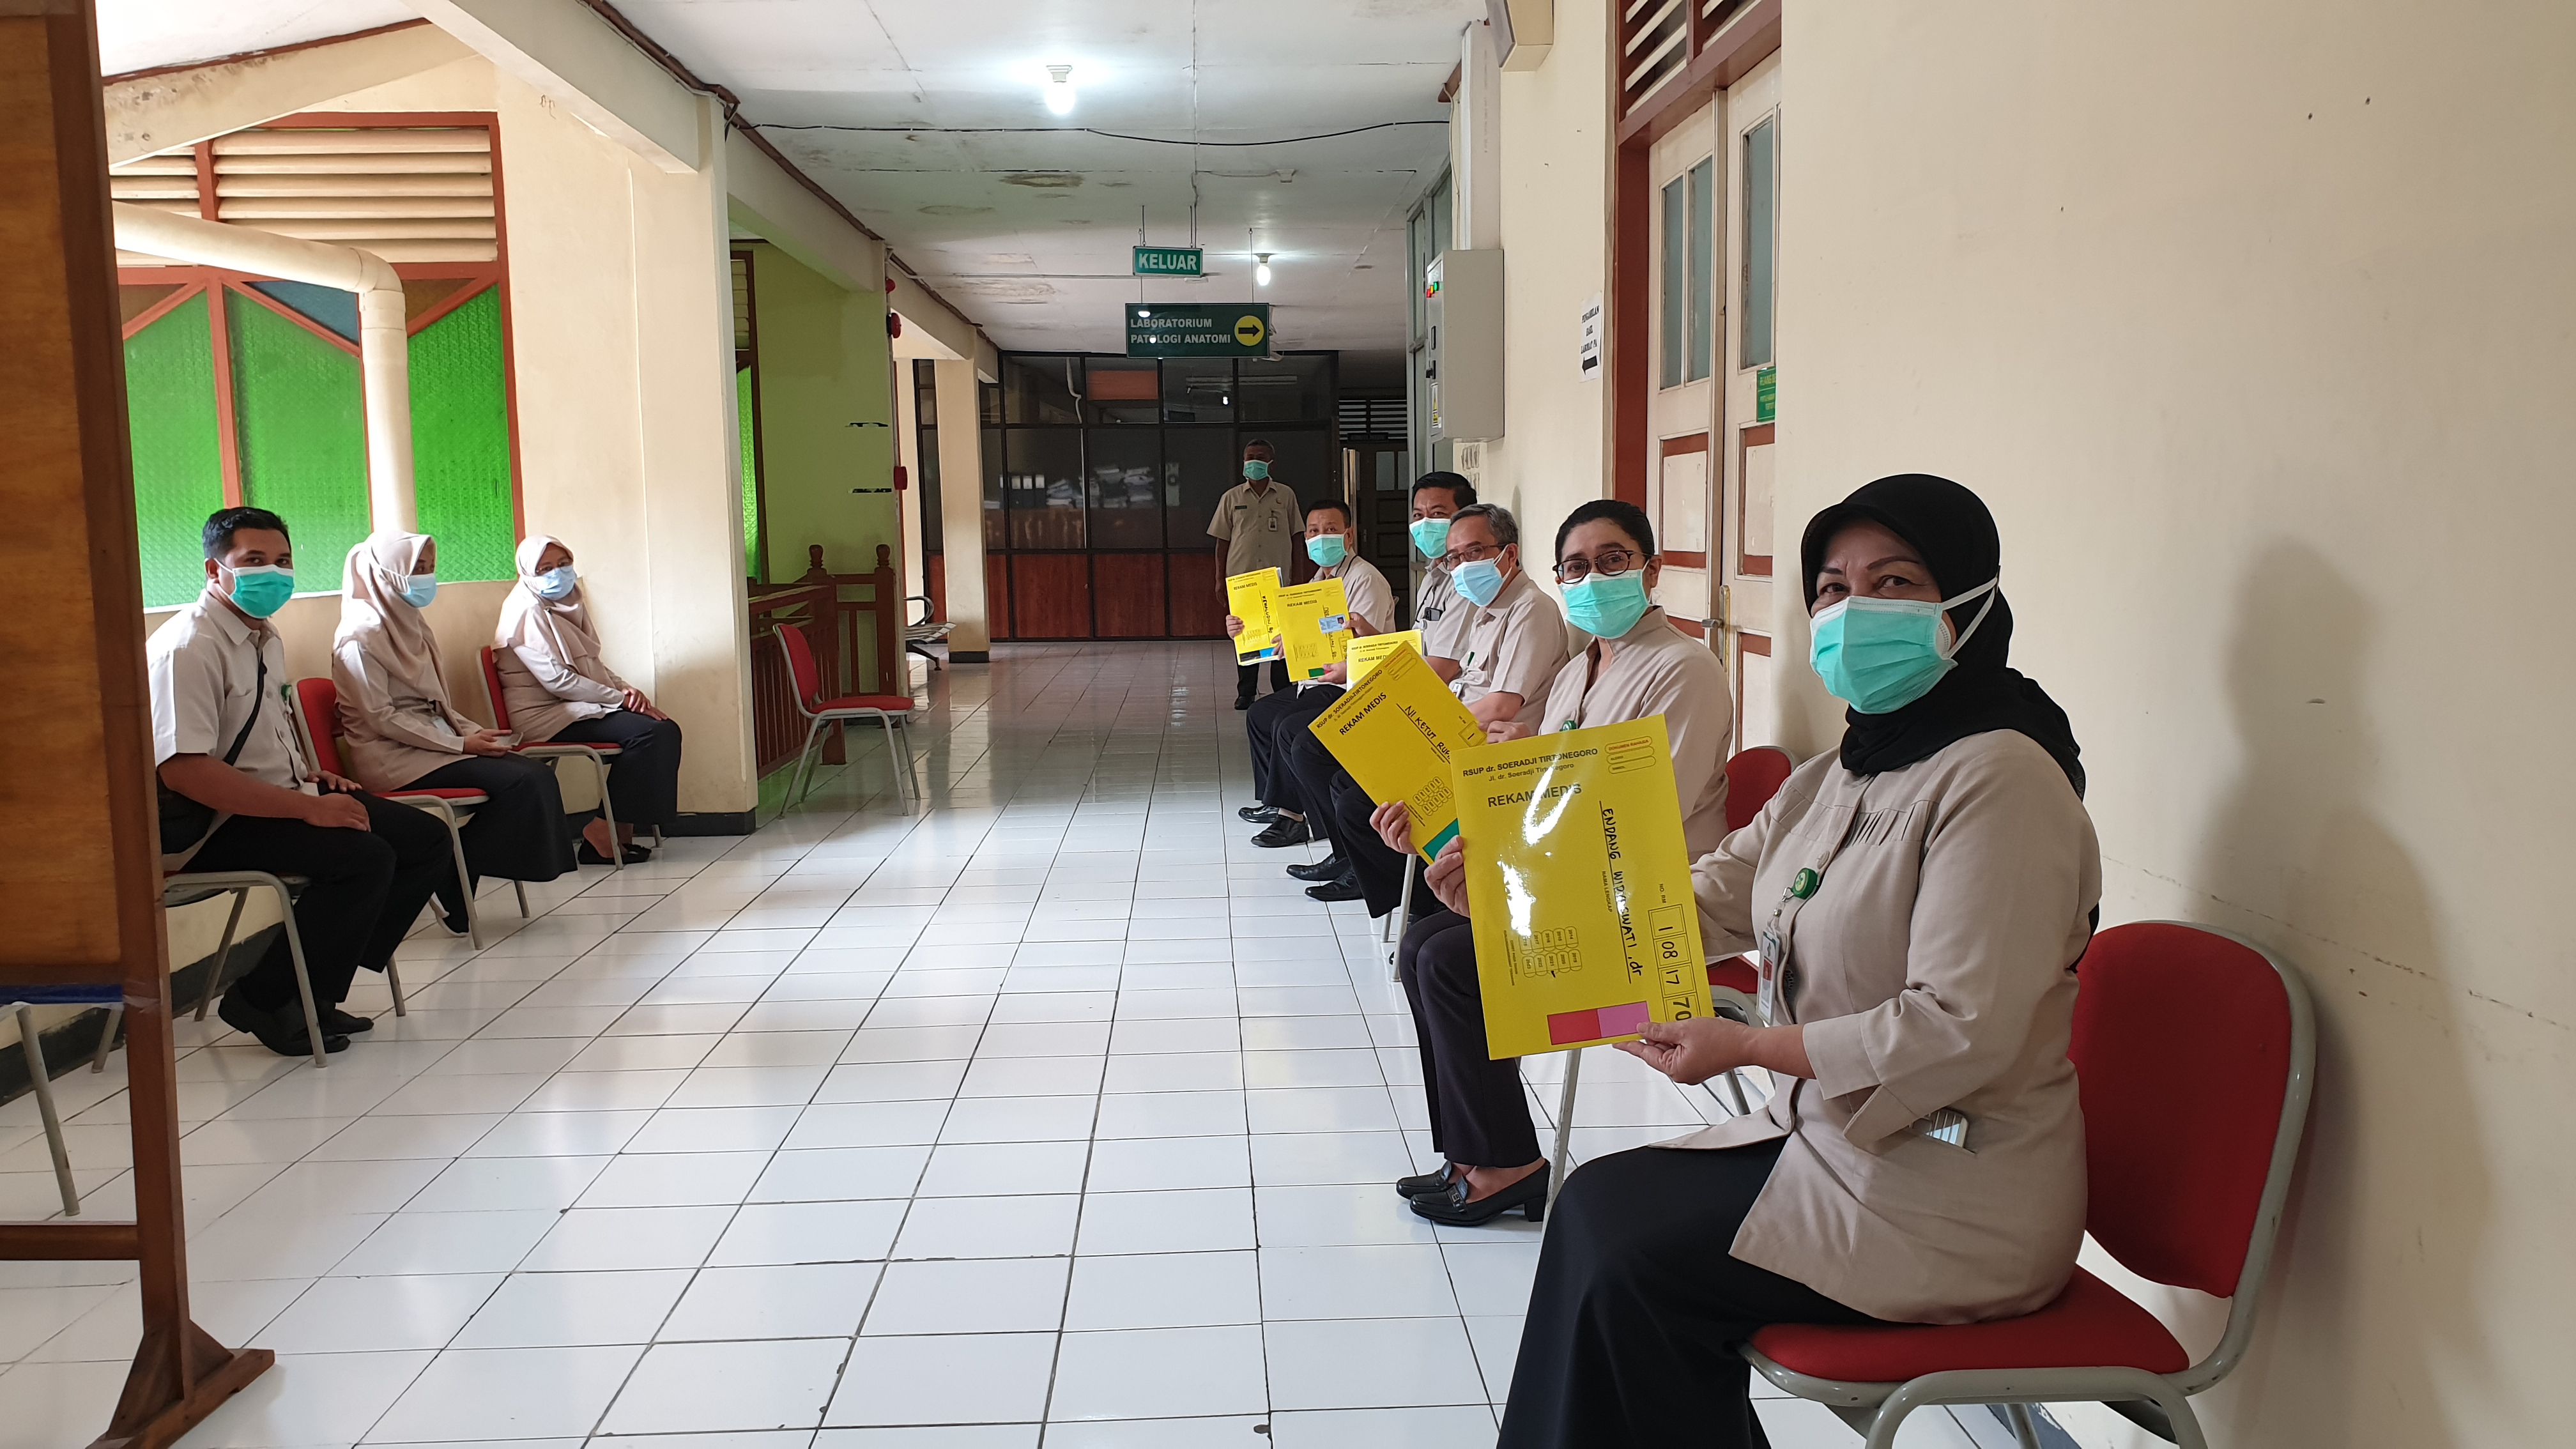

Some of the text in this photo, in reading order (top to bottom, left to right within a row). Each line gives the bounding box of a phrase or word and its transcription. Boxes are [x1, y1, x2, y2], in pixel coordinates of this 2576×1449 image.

[1138, 253, 1197, 270] KELUAR
[1130, 319, 1212, 328] LABORATORIUM
[1184, 334, 1230, 344] ANATOMI
[1317, 717, 1328, 729] RSUP
[1339, 711, 1365, 735] REKAM
[1363, 692, 1387, 714] MEDIS
[1405, 705, 1416, 717] NI
[1414, 717, 1436, 739] KETUT
[1462, 767, 1484, 777] RSUP
[1497, 758, 1537, 770] SOERADJI
[1538, 748, 1598, 763] TIRTONEGORO
[1507, 768, 1535, 779] Soeradji
[1536, 763, 1574, 774] Tirtegoro
[1487, 783, 1582, 808] REKAM MEDS
[1602, 808, 1621, 859] ENDANG
[1604, 889, 1613, 912] LENGKAP
[1661, 941, 1678, 959] 08
[1666, 969, 1680, 985] 17
[1673, 997, 1692, 1021] 70
